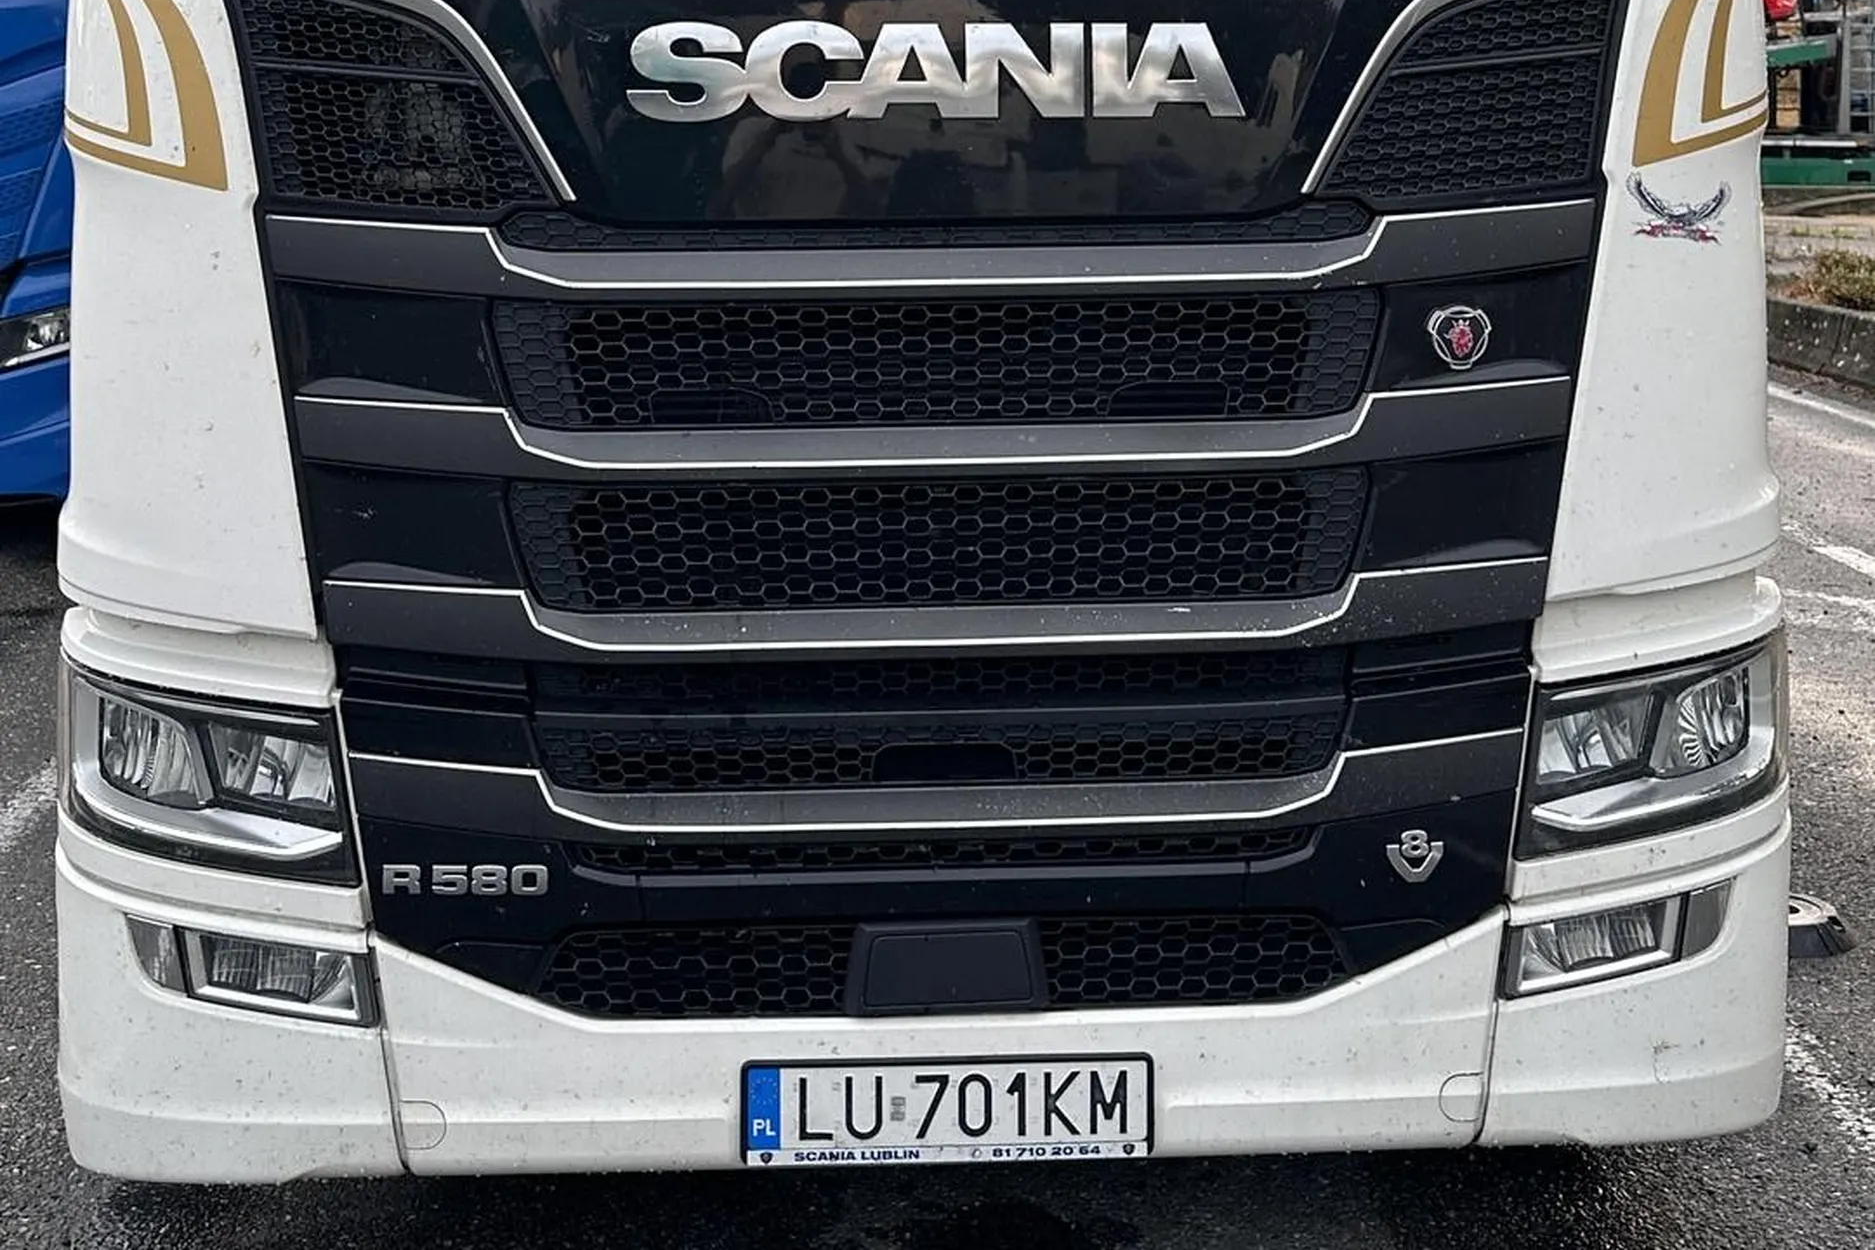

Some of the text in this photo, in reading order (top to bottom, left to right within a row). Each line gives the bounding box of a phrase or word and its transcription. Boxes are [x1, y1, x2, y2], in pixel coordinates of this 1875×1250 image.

[626, 21, 1247, 122] SCANIA
[382, 864, 549, 896] R 580
[799, 1070, 1128, 1141] LU 701KM
[752, 1118, 776, 1137] PL
[794, 1149, 920, 1162] SCANIA LUBLIN
[992, 1147, 1011, 1158] 81
[1016, 1146, 1046, 1158] 710
[1051, 1145, 1074, 1157] 20
